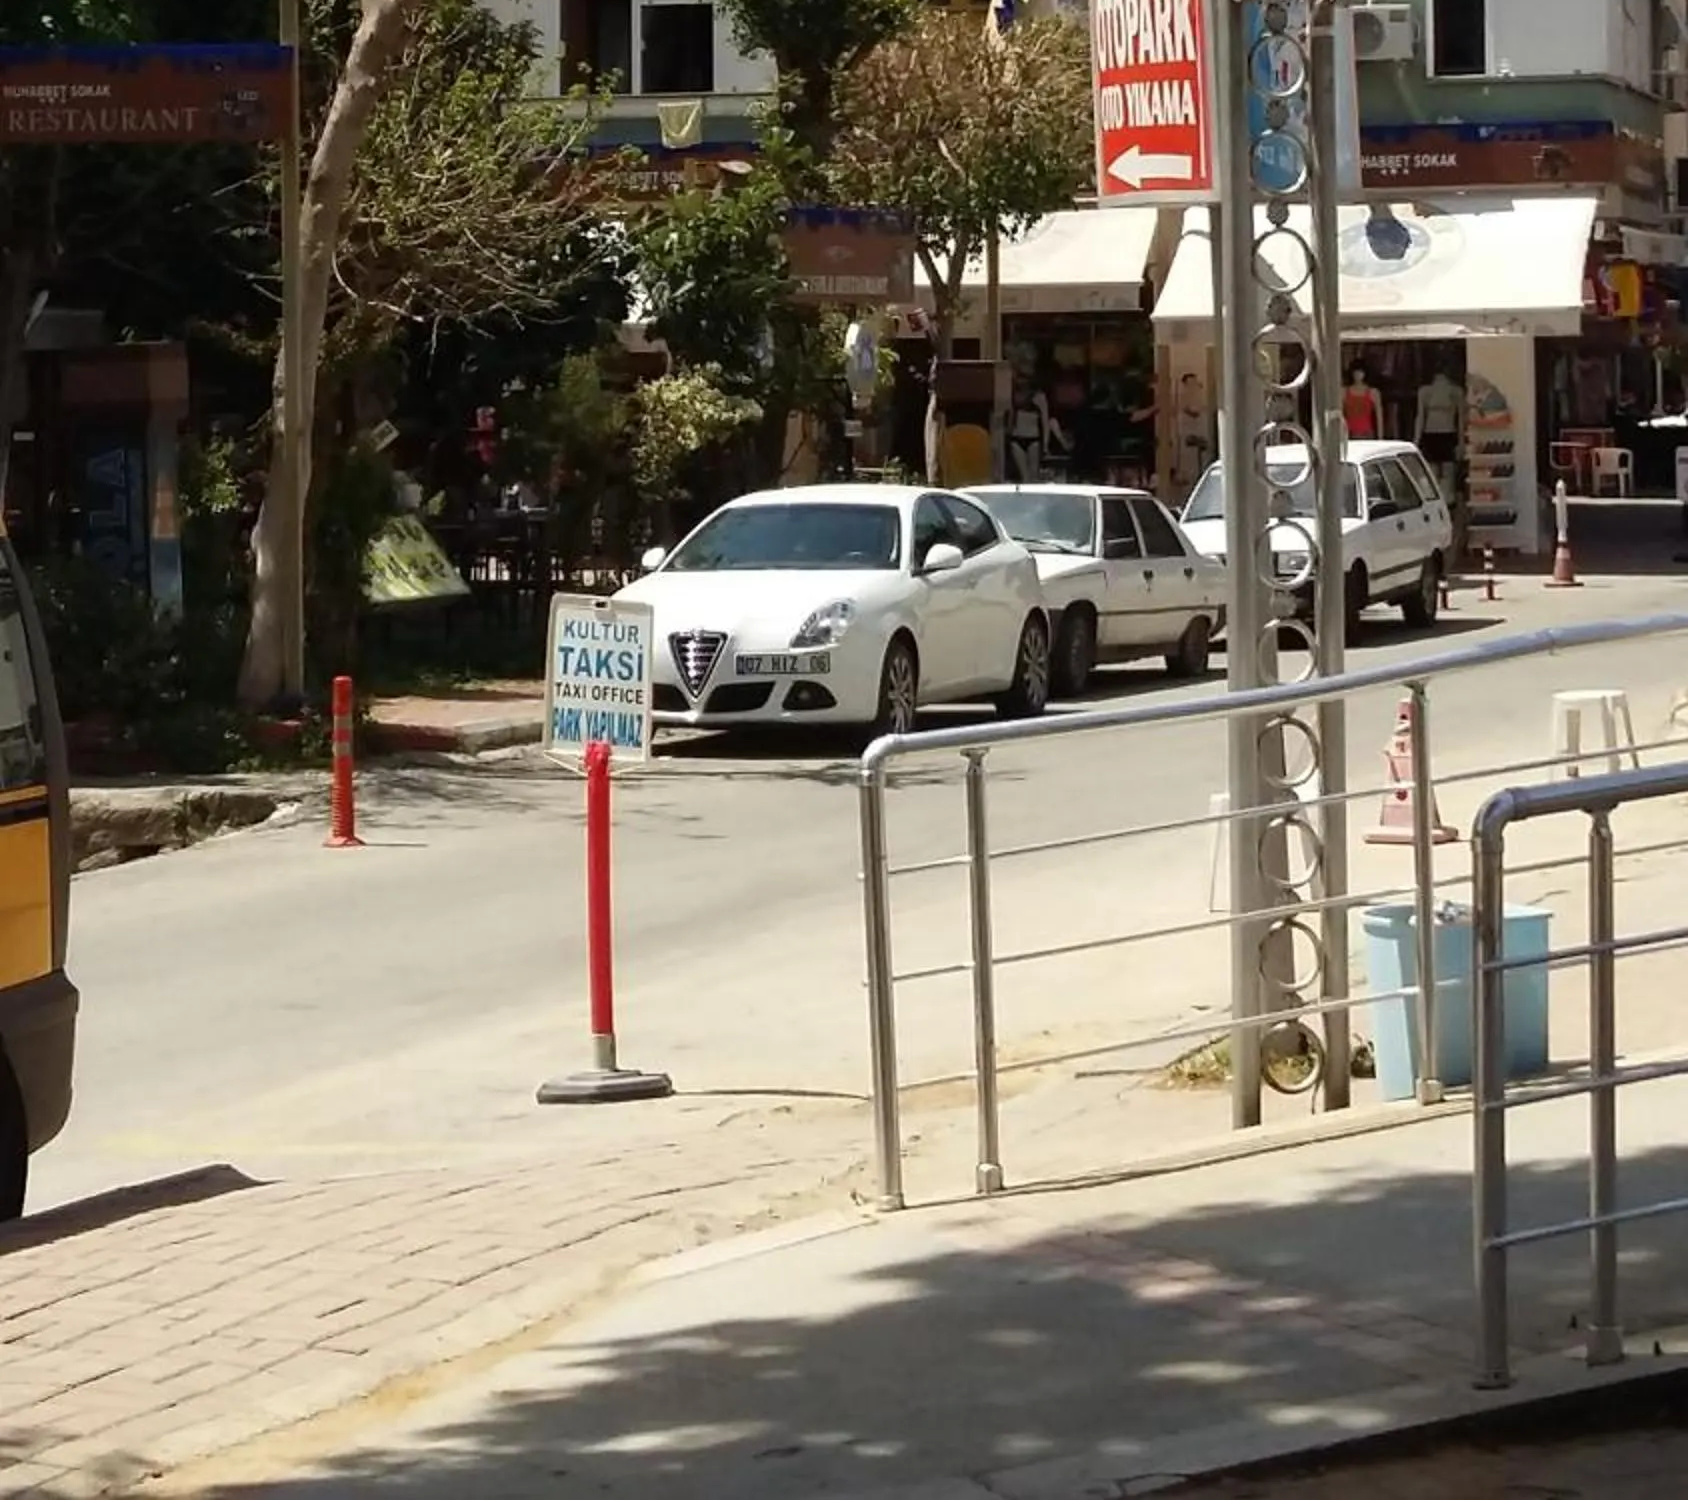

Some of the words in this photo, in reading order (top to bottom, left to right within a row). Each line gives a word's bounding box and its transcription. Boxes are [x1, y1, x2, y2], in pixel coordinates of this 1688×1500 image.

[8, 107, 200, 132] RESTAURANT
[1101, 84, 1124, 132] OTO
[1125, 80, 1197, 127] YIKAMA
[1361, 155, 1411, 169] HABBET
[1413, 153, 1457, 168] SOKAK
[558, 644, 643, 682] TAKSİ
[555, 681, 587, 699] TAXI
[591, 685, 644, 705] OFFICE
[552, 707, 580, 742] PARK
[586, 709, 644, 748] YAPILMAZ
